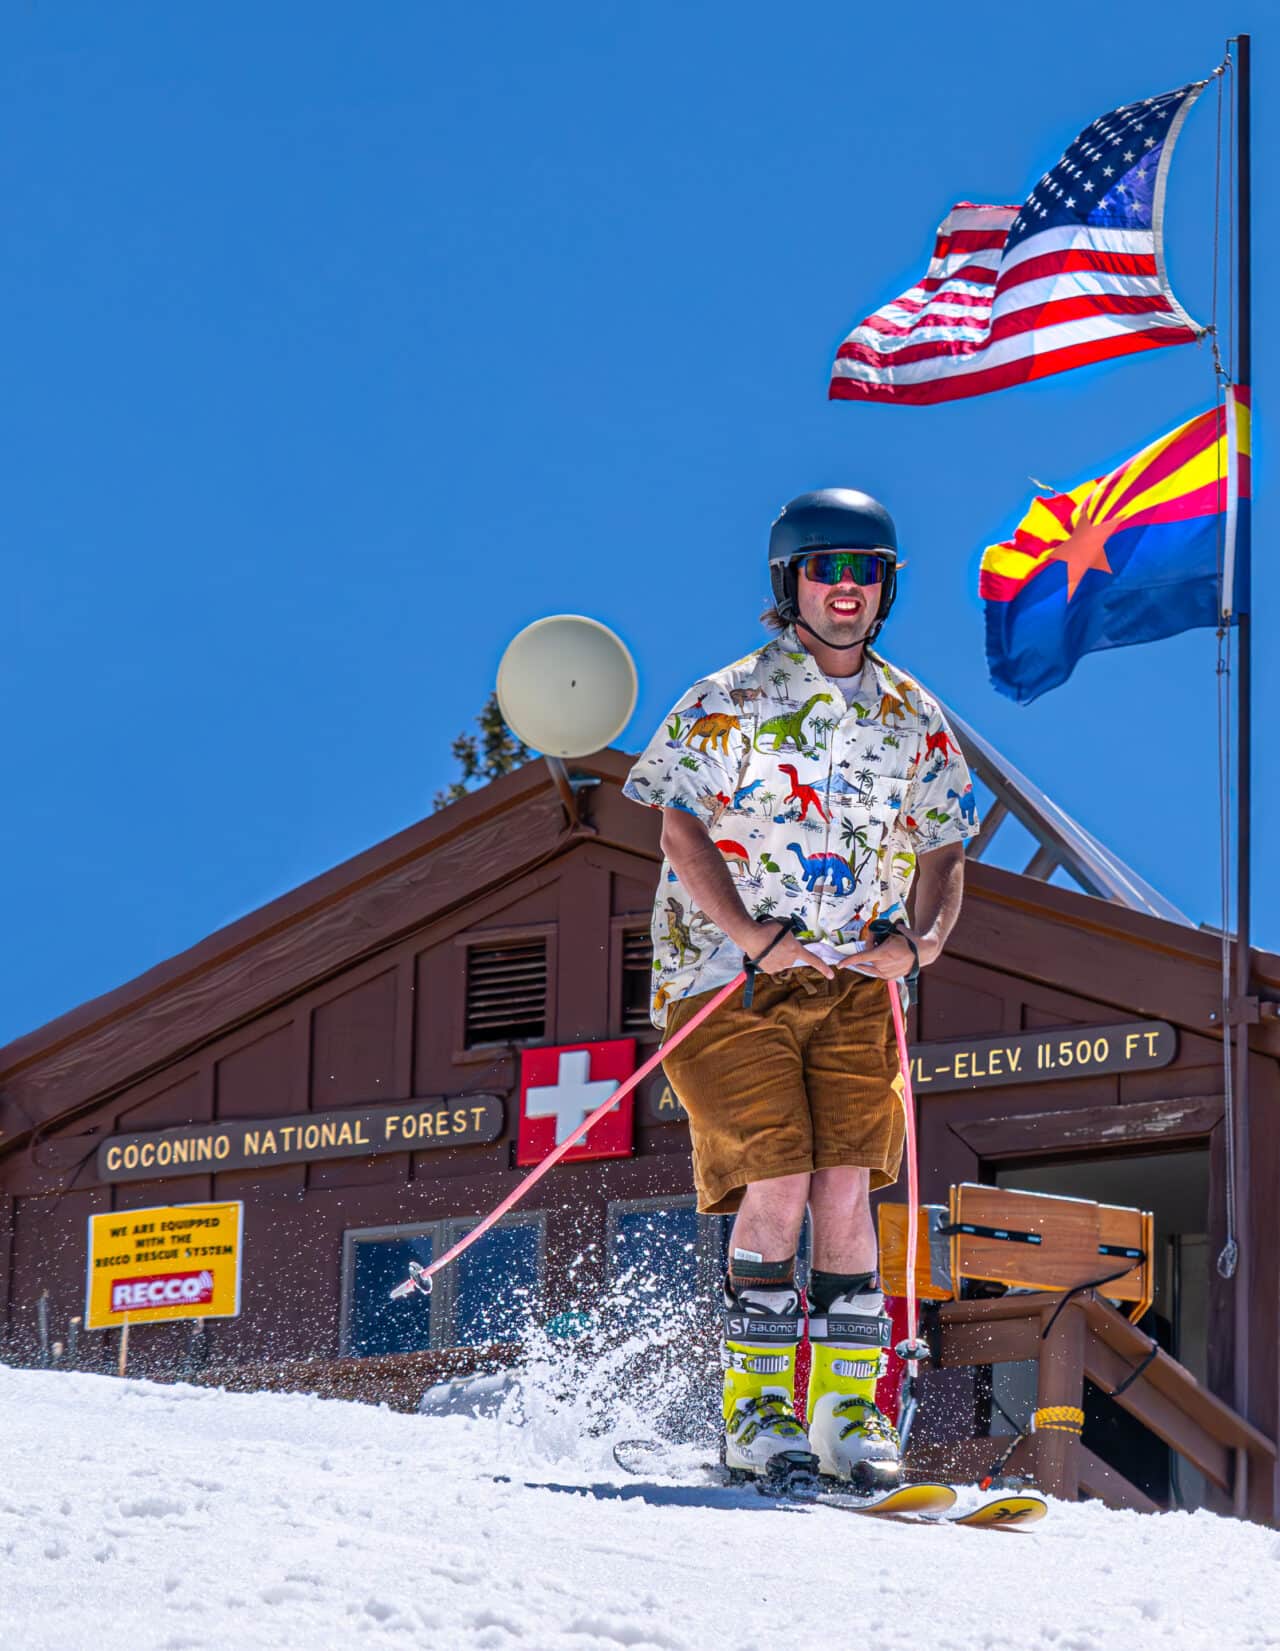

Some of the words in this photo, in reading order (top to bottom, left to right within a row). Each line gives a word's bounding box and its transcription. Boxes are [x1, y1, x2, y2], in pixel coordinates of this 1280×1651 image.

[1125, 1032, 1160, 1060] FT.
[106, 1134, 231, 1171] COCONINO
[244, 1119, 370, 1157] NATIONAL
[384, 1107, 486, 1141] FOREST
[110, 1226, 127, 1238] WE
[133, 1223, 155, 1235] ARE
[160, 1217, 220, 1232] EQUIPPED
[135, 1237, 165, 1249] WITH
[171, 1234, 192, 1244] THE
[95, 1255, 131, 1268] RECCO
[136, 1249, 179, 1263] RESCUE
[184, 1245, 233, 1258] SYSTEM
[113, 1277, 201, 1306] RECCO
